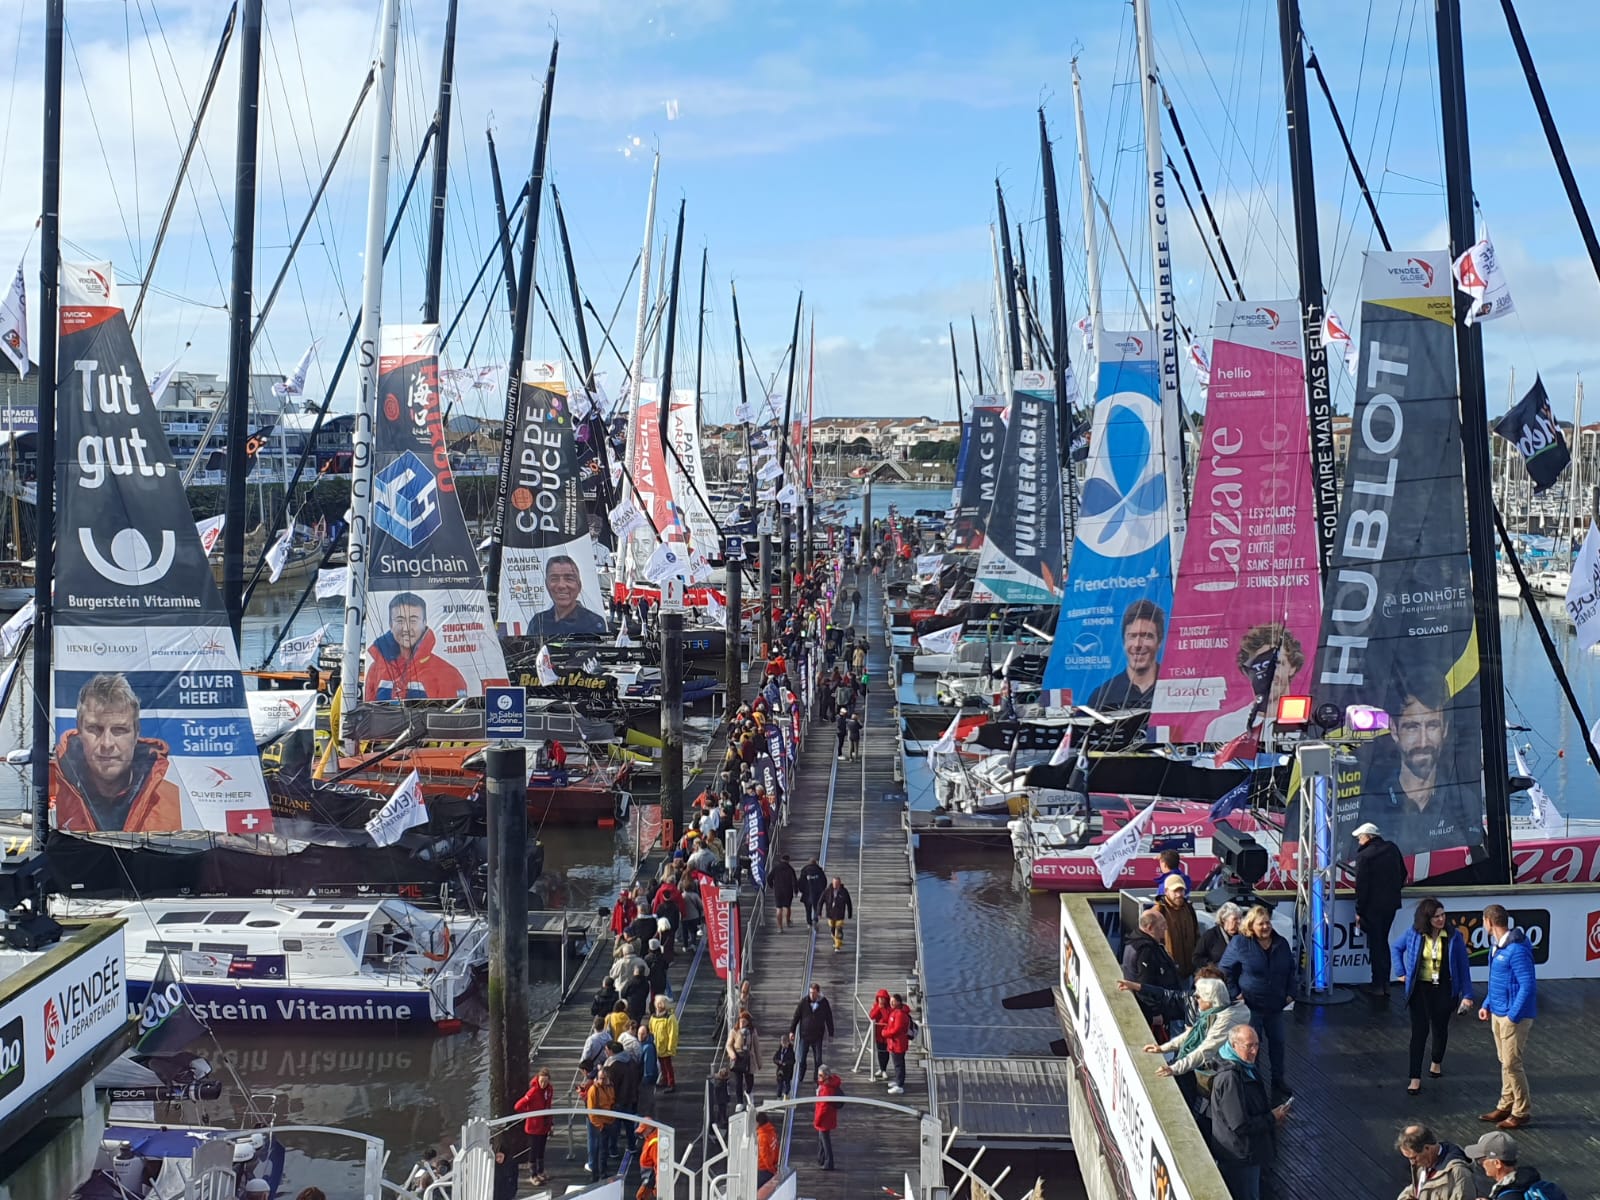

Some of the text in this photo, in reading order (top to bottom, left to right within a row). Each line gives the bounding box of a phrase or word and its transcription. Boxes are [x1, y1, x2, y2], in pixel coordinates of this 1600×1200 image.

[1153, 169, 1176, 391] FRENCHBEE.COM
[1217, 367, 1252, 379] hellio
[73, 360, 140, 415] Tut
[1312, 366, 1327, 399] PAS
[1315, 405, 1333, 447] MAIS
[77, 428, 167, 489] gut.
[641, 418, 654, 486] APICIL
[980, 415, 994, 501] MACSF
[499, 438, 512, 498] commence
[535, 431, 562, 533] POUCE
[1016, 401, 1038, 557] VULNERABLE
[1319, 451, 1338, 539] SOLITAIRE
[494, 500, 505, 534] Demain
[1193, 427, 1243, 592] Lazare
[1248, 505, 1296, 519] LES COLOCS
[1321, 340, 1408, 686] HUBLOT
[1248, 523, 1296, 537] SOLIDAIRES
[1247, 541, 1274, 554] ENTRE
[380, 553, 468, 577] Singchain
[506, 556, 542, 565] MANUEL
[507, 564, 539, 572] COUSIN
[1295, 557, 1305, 569] ET
[1073, 575, 1146, 592] Frenchbee
[1246, 575, 1279, 588] JEUNES
[68, 595, 201, 610] Burgerstein Vitamine
[1082, 618, 1114, 626] SIMON
[443, 634, 466, 643] TEAM
[1179, 626, 1210, 637] TANGUY
[67, 644, 138, 653] HENRI LLOYD
[1178, 640, 1188, 650] LE
[1168, 667, 1196, 676] TEAM
[179, 675, 234, 688] OLIVER
[568, 672, 607, 689] Vallée
[179, 691, 219, 704] HEER
[1167, 686, 1209, 697] Lazare
[182, 724, 240, 739] Tut gut.
[183, 739, 234, 754] Sailing
[1337, 811, 1358, 823] Team
[1151, 822, 1204, 837] Lazare
[1033, 865, 1057, 875] GET
[1059, 865, 1095, 875] YOUR
[59, 956, 120, 1026] VENDÉE
[276, 999, 412, 1022] Vitamine
[61, 992, 120, 1048] LE DÉPARTEMENT
